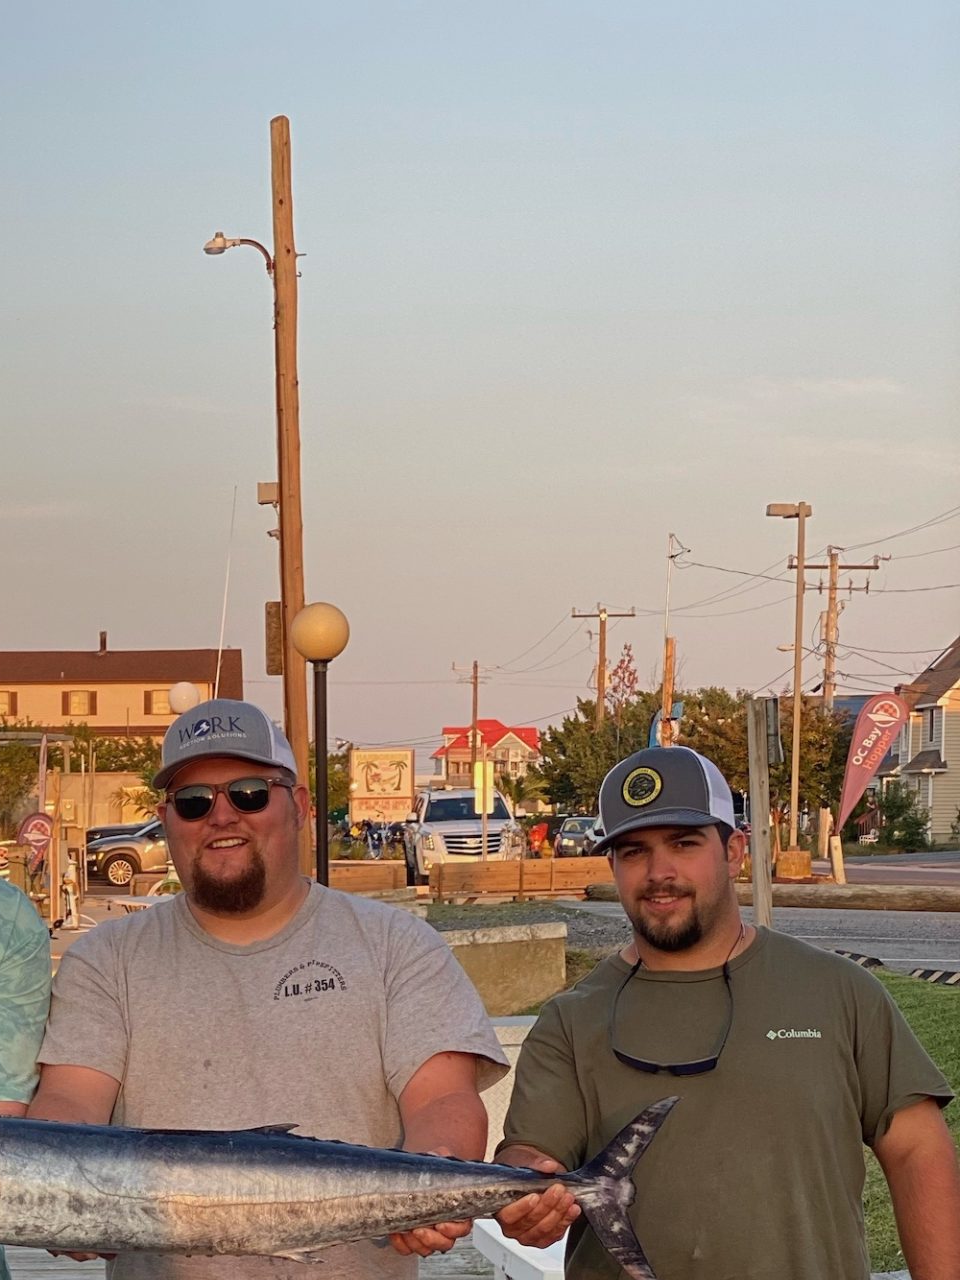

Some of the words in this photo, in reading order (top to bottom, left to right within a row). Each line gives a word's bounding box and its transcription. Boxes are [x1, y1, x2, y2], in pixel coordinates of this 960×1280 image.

[178, 715, 246, 743] WORK
[852, 747, 869, 766] OC
[862, 727, 882, 749] Bay
[862, 728, 892, 770] Hopper
[314, 977, 336, 992] 354
[777, 1028, 822, 1039] Columbia
